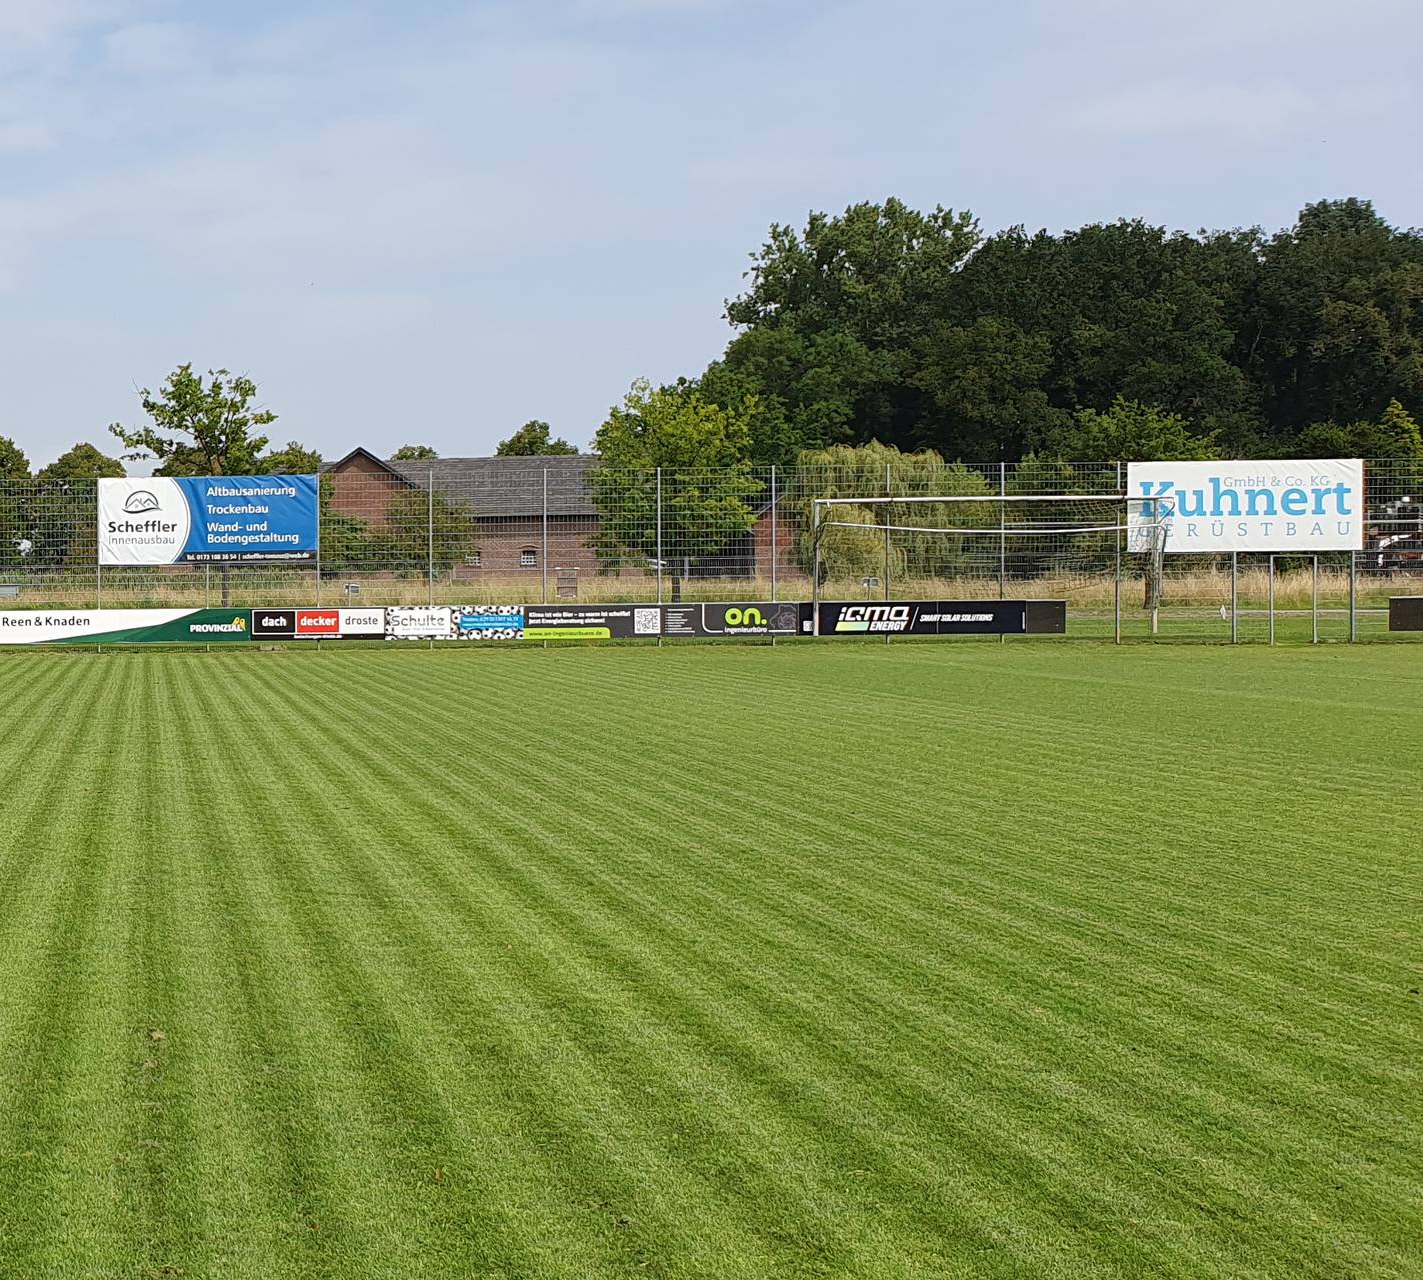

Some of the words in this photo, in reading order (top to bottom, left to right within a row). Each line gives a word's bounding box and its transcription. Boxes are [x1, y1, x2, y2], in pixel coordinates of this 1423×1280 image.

[1224, 476, 1265, 488] GmbH
[1270, 477, 1282, 487] &
[1285, 476, 1305, 488] Co.
[1310, 475, 1330, 487] KG
[206, 486, 296, 497] Altbausanierung
[1139, 477, 1352, 518] Kuhnert
[206, 504, 269, 514] Trockenbau
[108, 520, 178, 533] Scheffler
[207, 522, 243, 532] Wand-
[246, 521, 267, 531] und
[207, 533, 299, 544] Bodengestaltung
[2, 617, 32, 627] Reen
[34, 617, 43, 626] &
[45, 616, 90, 626] Knaden
[261, 616, 287, 627] dach
[300, 616, 337, 626] decker
[345, 616, 379, 625] droste
[391, 614, 445, 627] Schulte
[725, 607, 767, 625] on.
[919, 614, 941, 622] SMART
[941, 613, 961, 622] SOLAR
[961, 613, 993, 622] SOLUTIONS
[190, 624, 242, 633] PROVINZIAL
[869, 620, 907, 631] ENERGY
